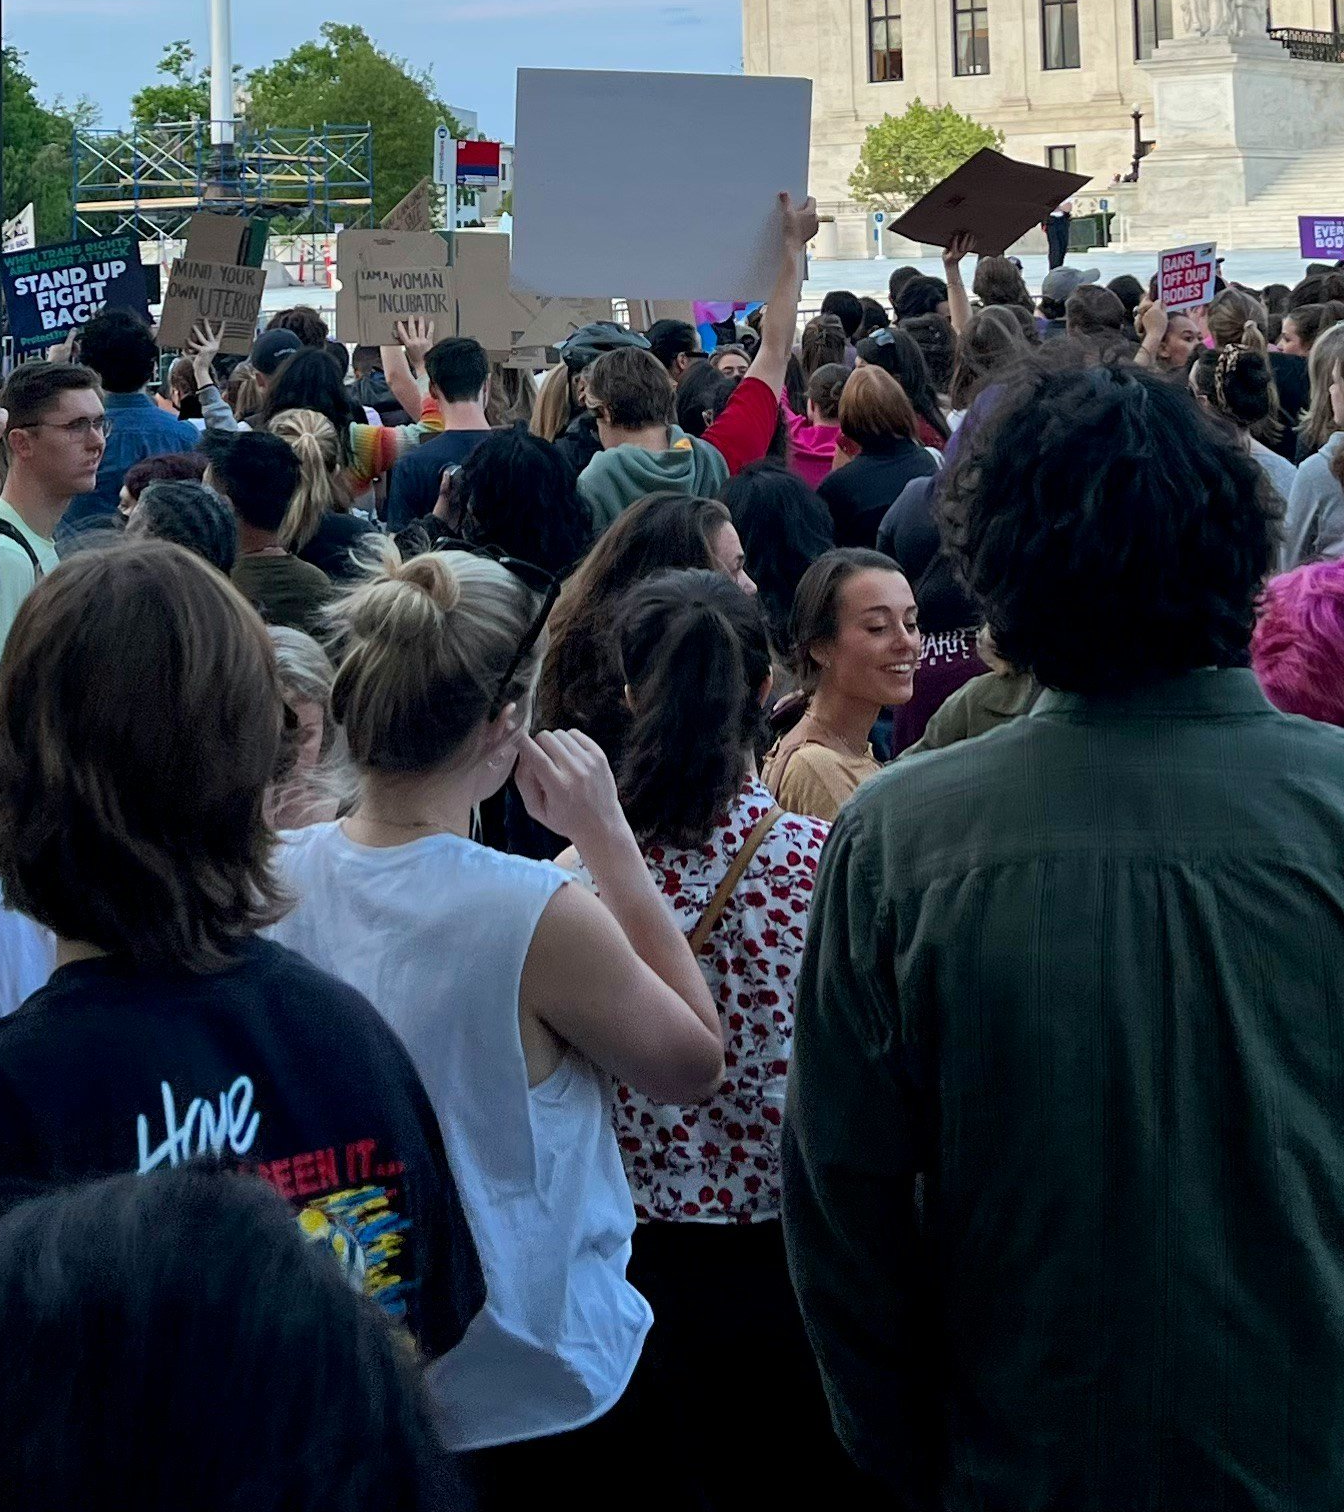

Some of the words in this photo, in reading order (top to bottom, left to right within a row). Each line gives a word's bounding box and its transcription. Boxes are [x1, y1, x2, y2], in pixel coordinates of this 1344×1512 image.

[4, 252, 38, 267] WHEN
[41, 244, 82, 260] TRANS
[84, 236, 131, 252] RIGHTS
[9, 264, 31, 276] ARE
[34, 256, 74, 271] UNDER
[78, 246, 131, 263] ATTACK
[1163, 252, 1194, 272] BANS
[14, 266, 88, 296] STAND
[92, 260, 127, 281] UP
[174, 260, 212, 280] MIND
[219, 266, 256, 287] YOUR
[389, 272, 444, 290] WOMAN
[1163, 271, 1184, 289] OFF
[1185, 265, 1208, 283] OUR
[36, 280, 107, 311] FIGHT
[168, 282, 198, 300] OWN
[199, 288, 261, 323] UTERUS
[378, 292, 449, 314] INCUBATOR
[1163, 284, 1202, 305] BODIES
